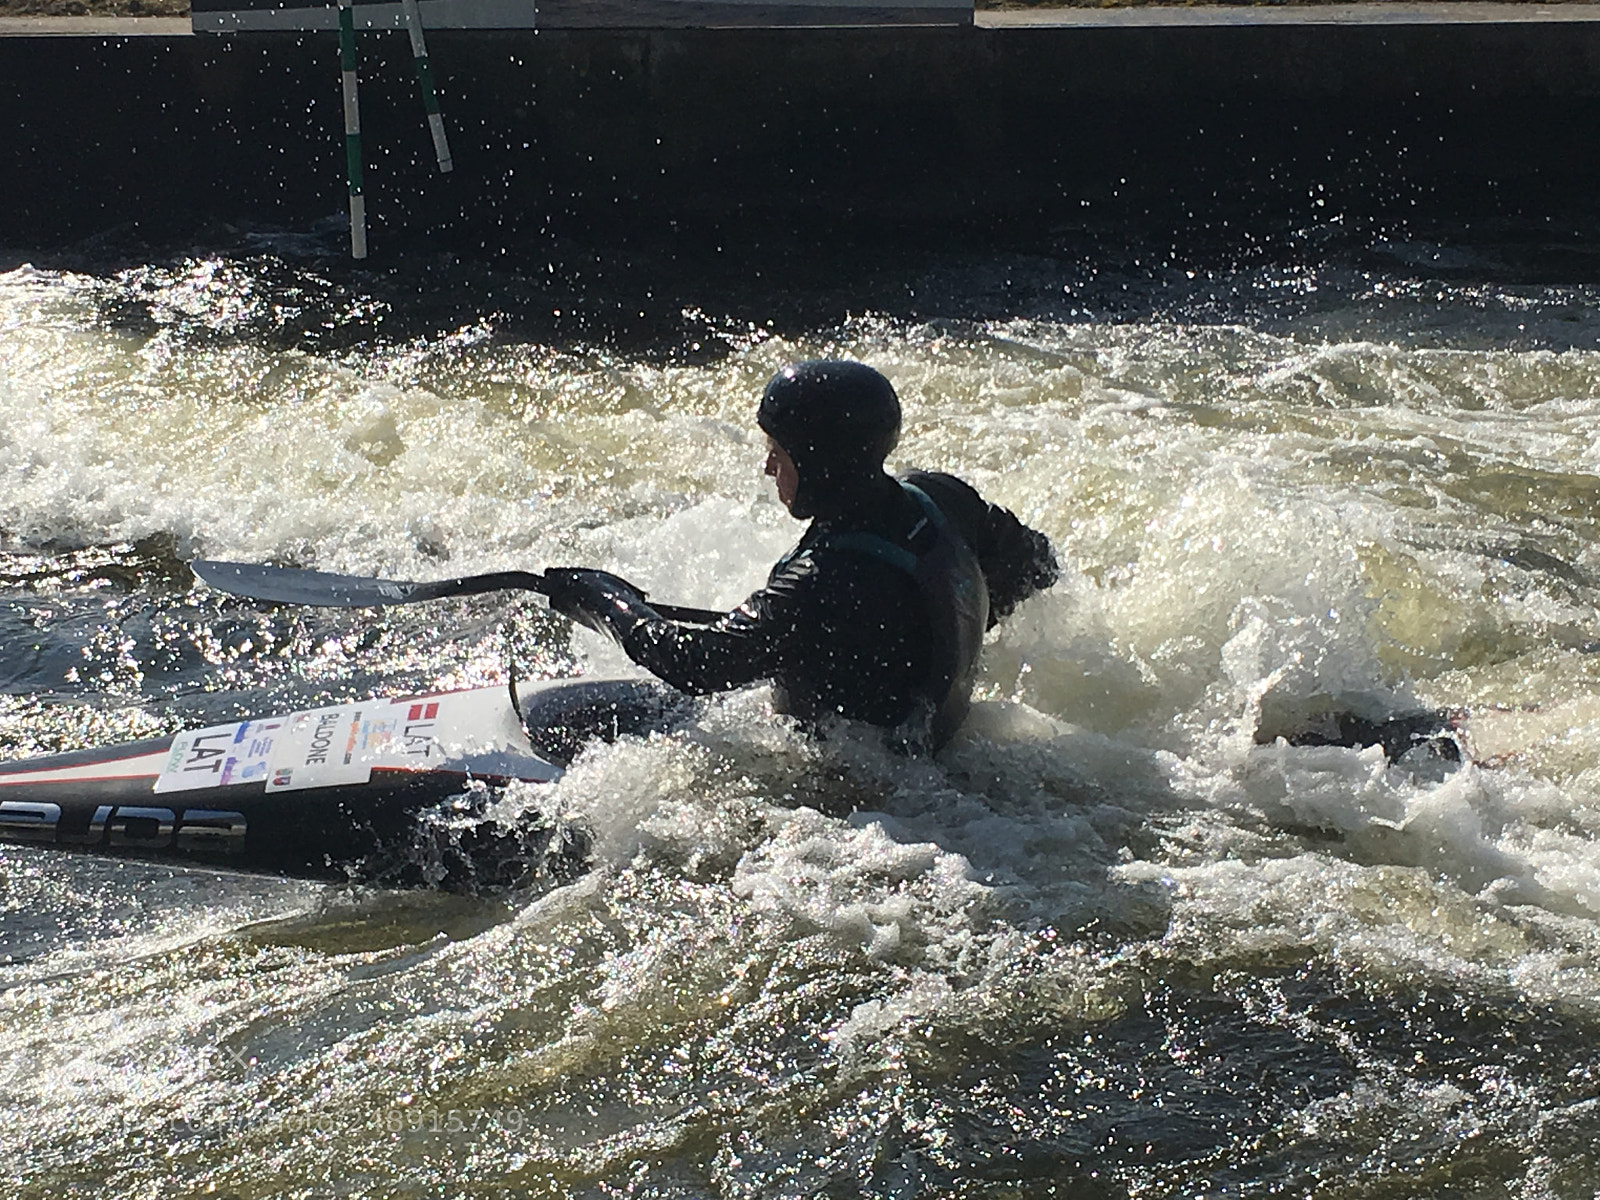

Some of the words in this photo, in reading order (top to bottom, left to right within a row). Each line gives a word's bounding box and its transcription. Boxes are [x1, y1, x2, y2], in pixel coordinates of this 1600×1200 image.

[187, 733, 232, 773] LAT
[306, 713, 340, 766] BALDONE
[404, 723, 436, 758] LAT
